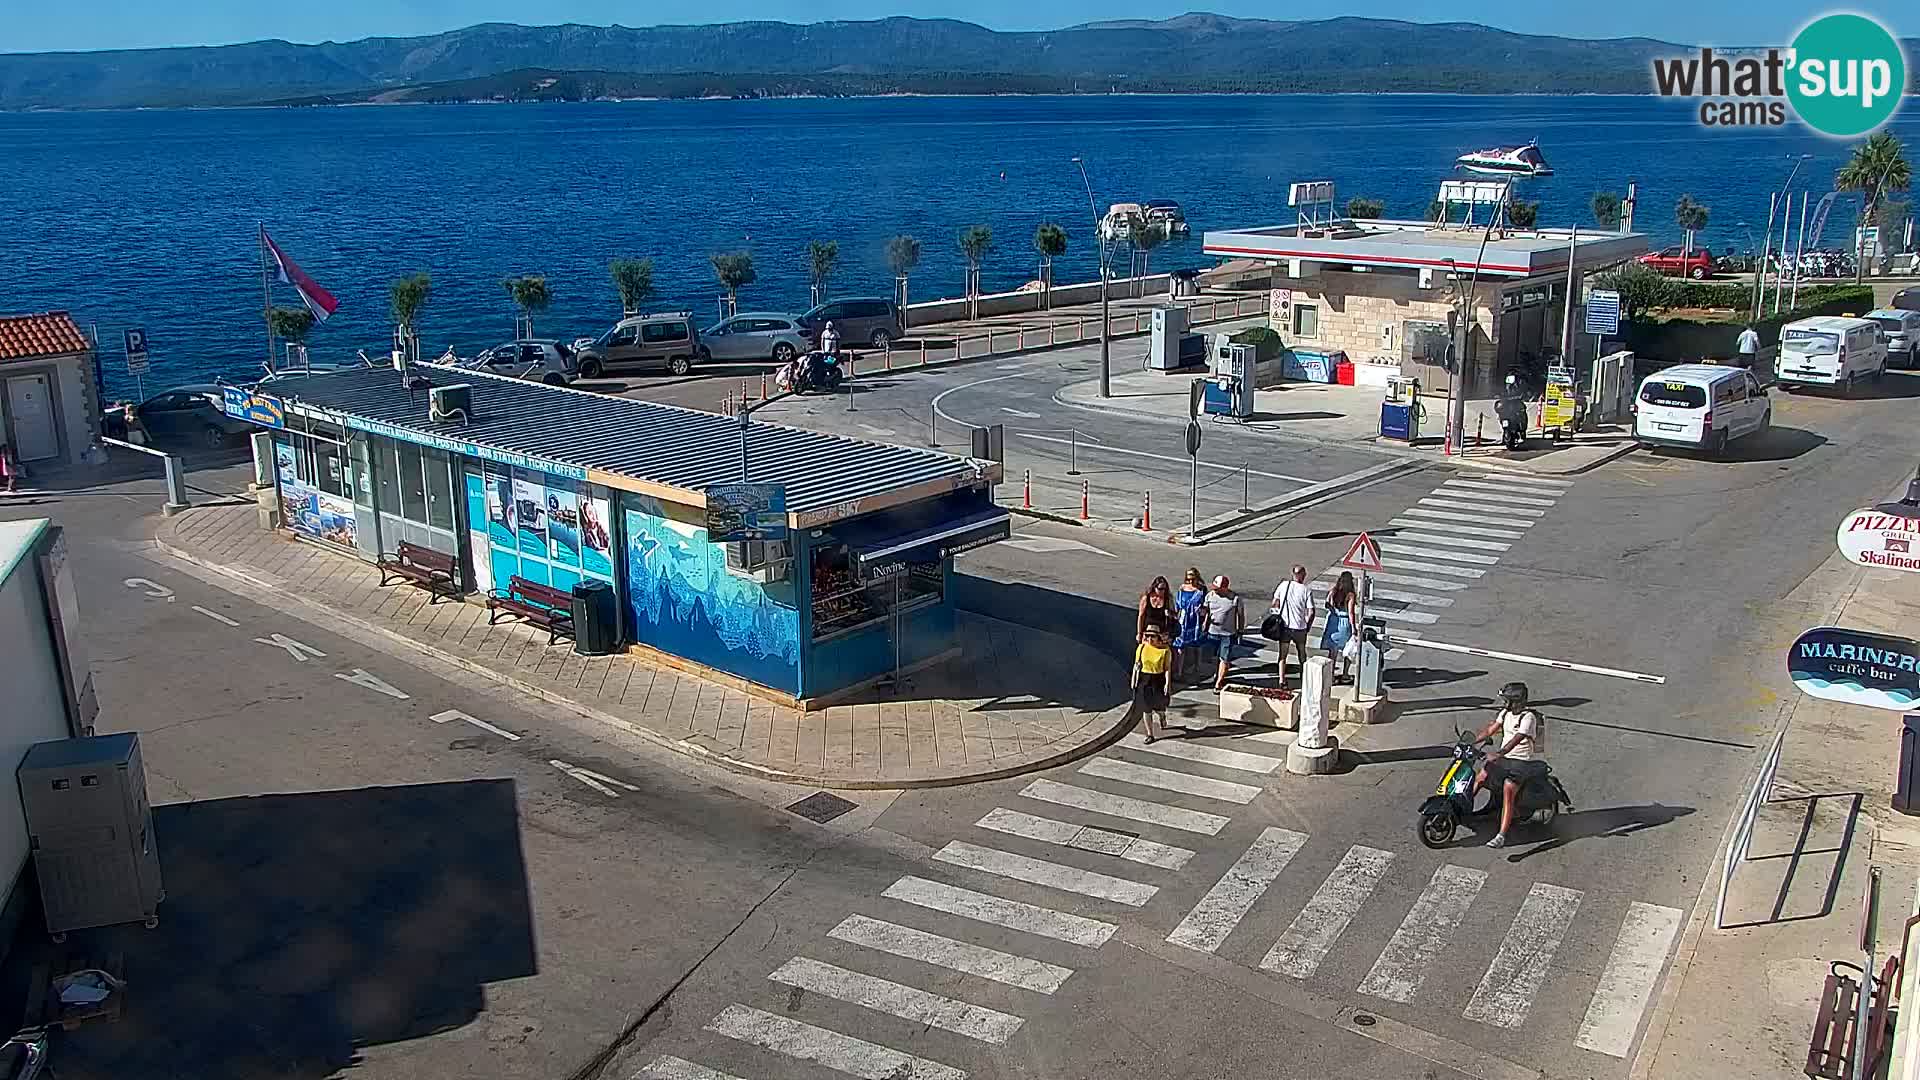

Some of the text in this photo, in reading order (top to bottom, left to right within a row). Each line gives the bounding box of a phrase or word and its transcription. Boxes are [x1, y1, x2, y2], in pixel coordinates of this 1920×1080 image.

[129, 332, 141, 350] P
[1665, 383, 1684, 391] TAXI
[435, 437, 466, 452] POSTAJA
[477, 447, 582, 477] BUS STATION TICKET OFFICE
[1881, 530, 1917, 541] GRILL
[1828, 662, 1897, 681] caffe bar
